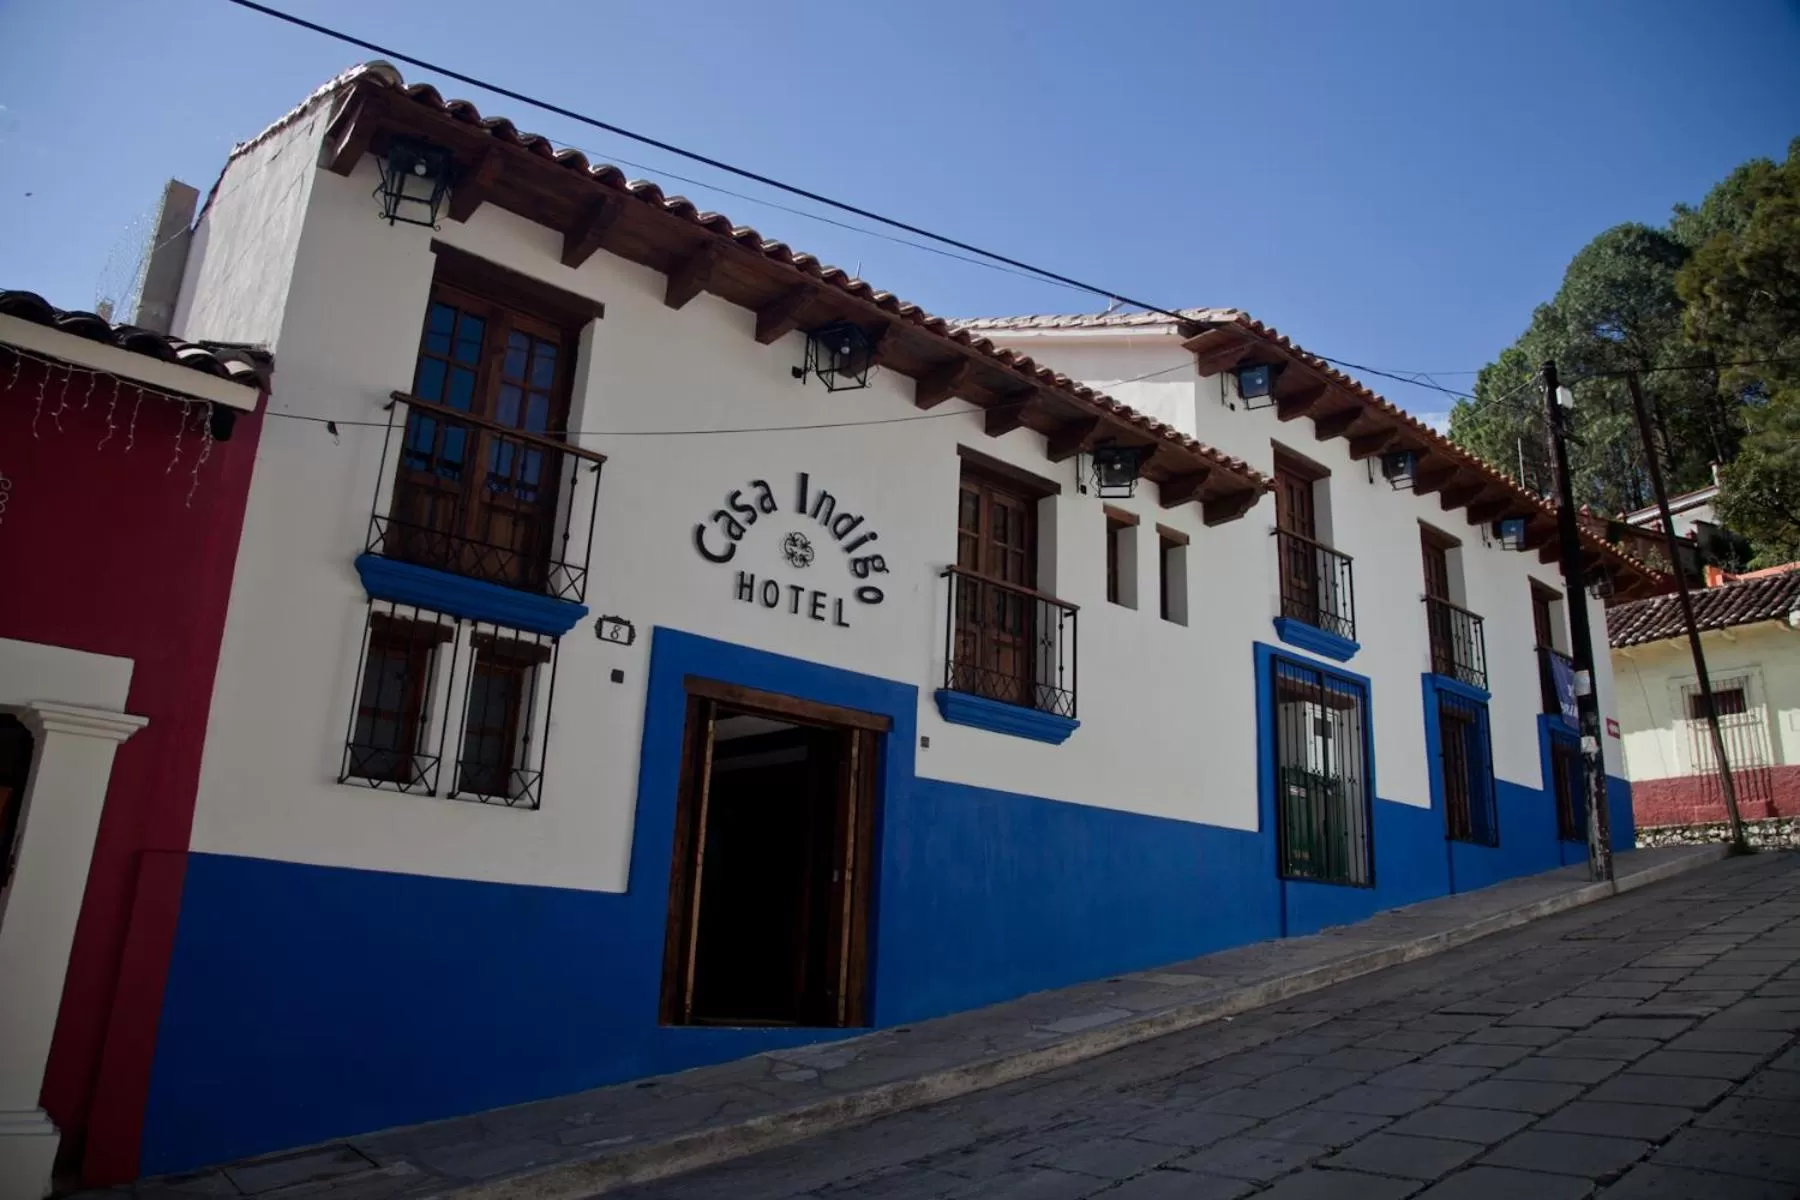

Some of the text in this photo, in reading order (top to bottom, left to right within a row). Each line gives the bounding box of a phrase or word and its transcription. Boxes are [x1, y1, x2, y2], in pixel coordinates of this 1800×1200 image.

[694, 472, 890, 604] Casa Indigo
[736, 570, 850, 628] HOTEL
[610, 624, 622, 640] 8
